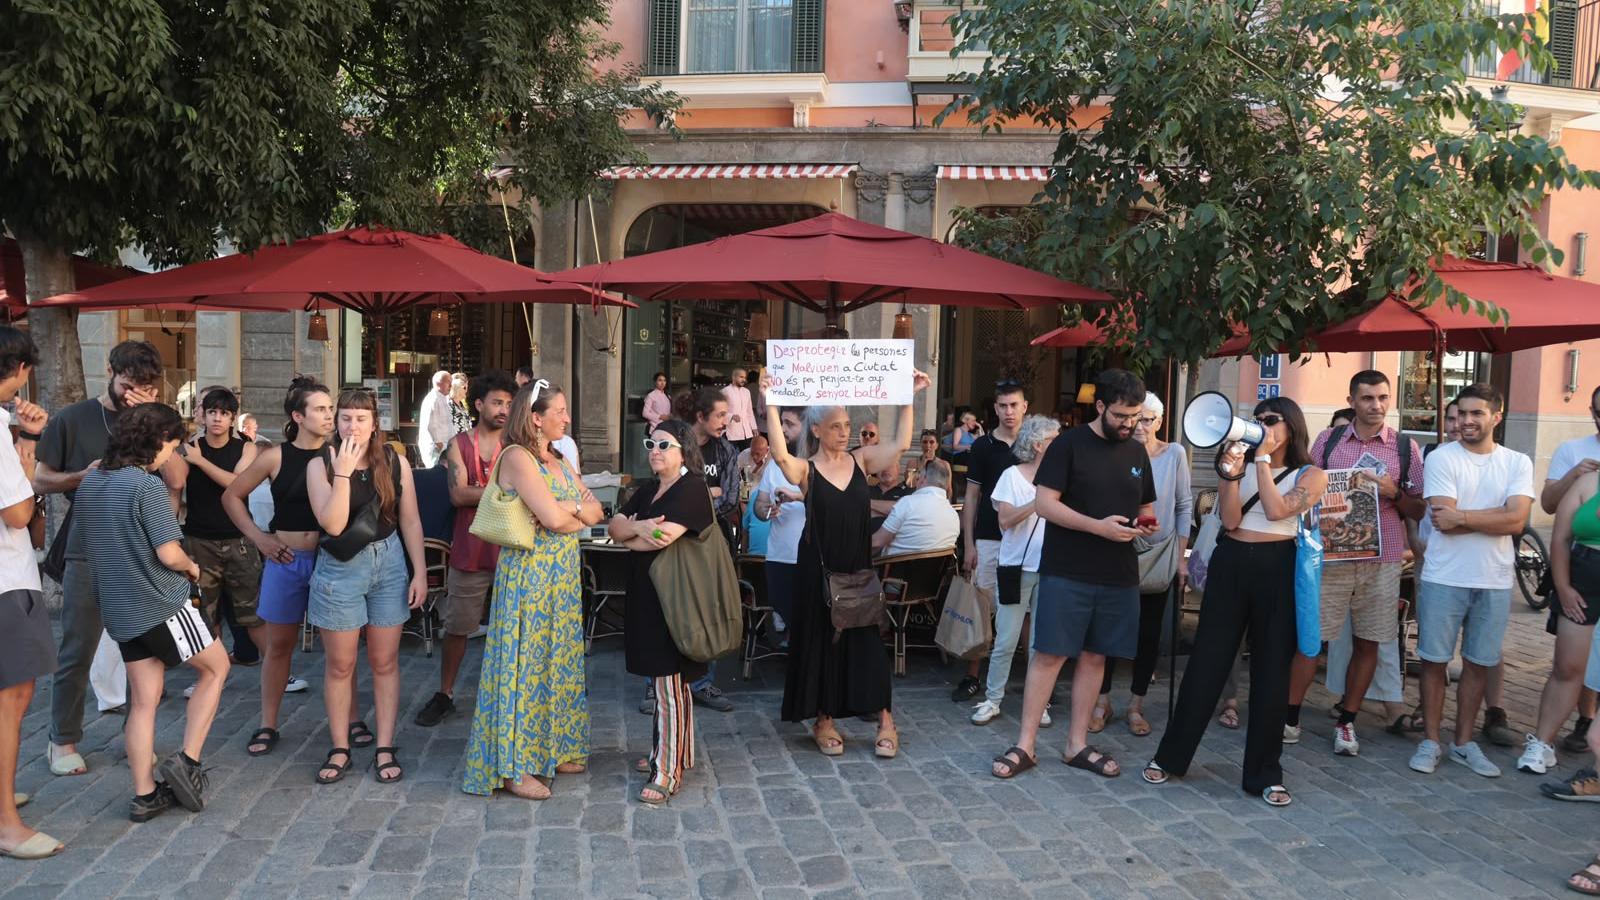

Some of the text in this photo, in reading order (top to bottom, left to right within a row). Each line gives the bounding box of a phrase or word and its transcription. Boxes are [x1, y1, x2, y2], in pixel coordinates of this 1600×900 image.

[773, 344, 846, 360] Desprotegir
[863, 347, 908, 361] persones
[772, 364, 785, 376] que
[853, 360, 898, 372] Ciutat
[768, 376, 783, 387] NO
[786, 375, 798, 386] és
[1328, 472, 1348, 482] ITATGE
[1327, 482, 1347, 493] COSTA
[1324, 493, 1344, 506] VIDA
